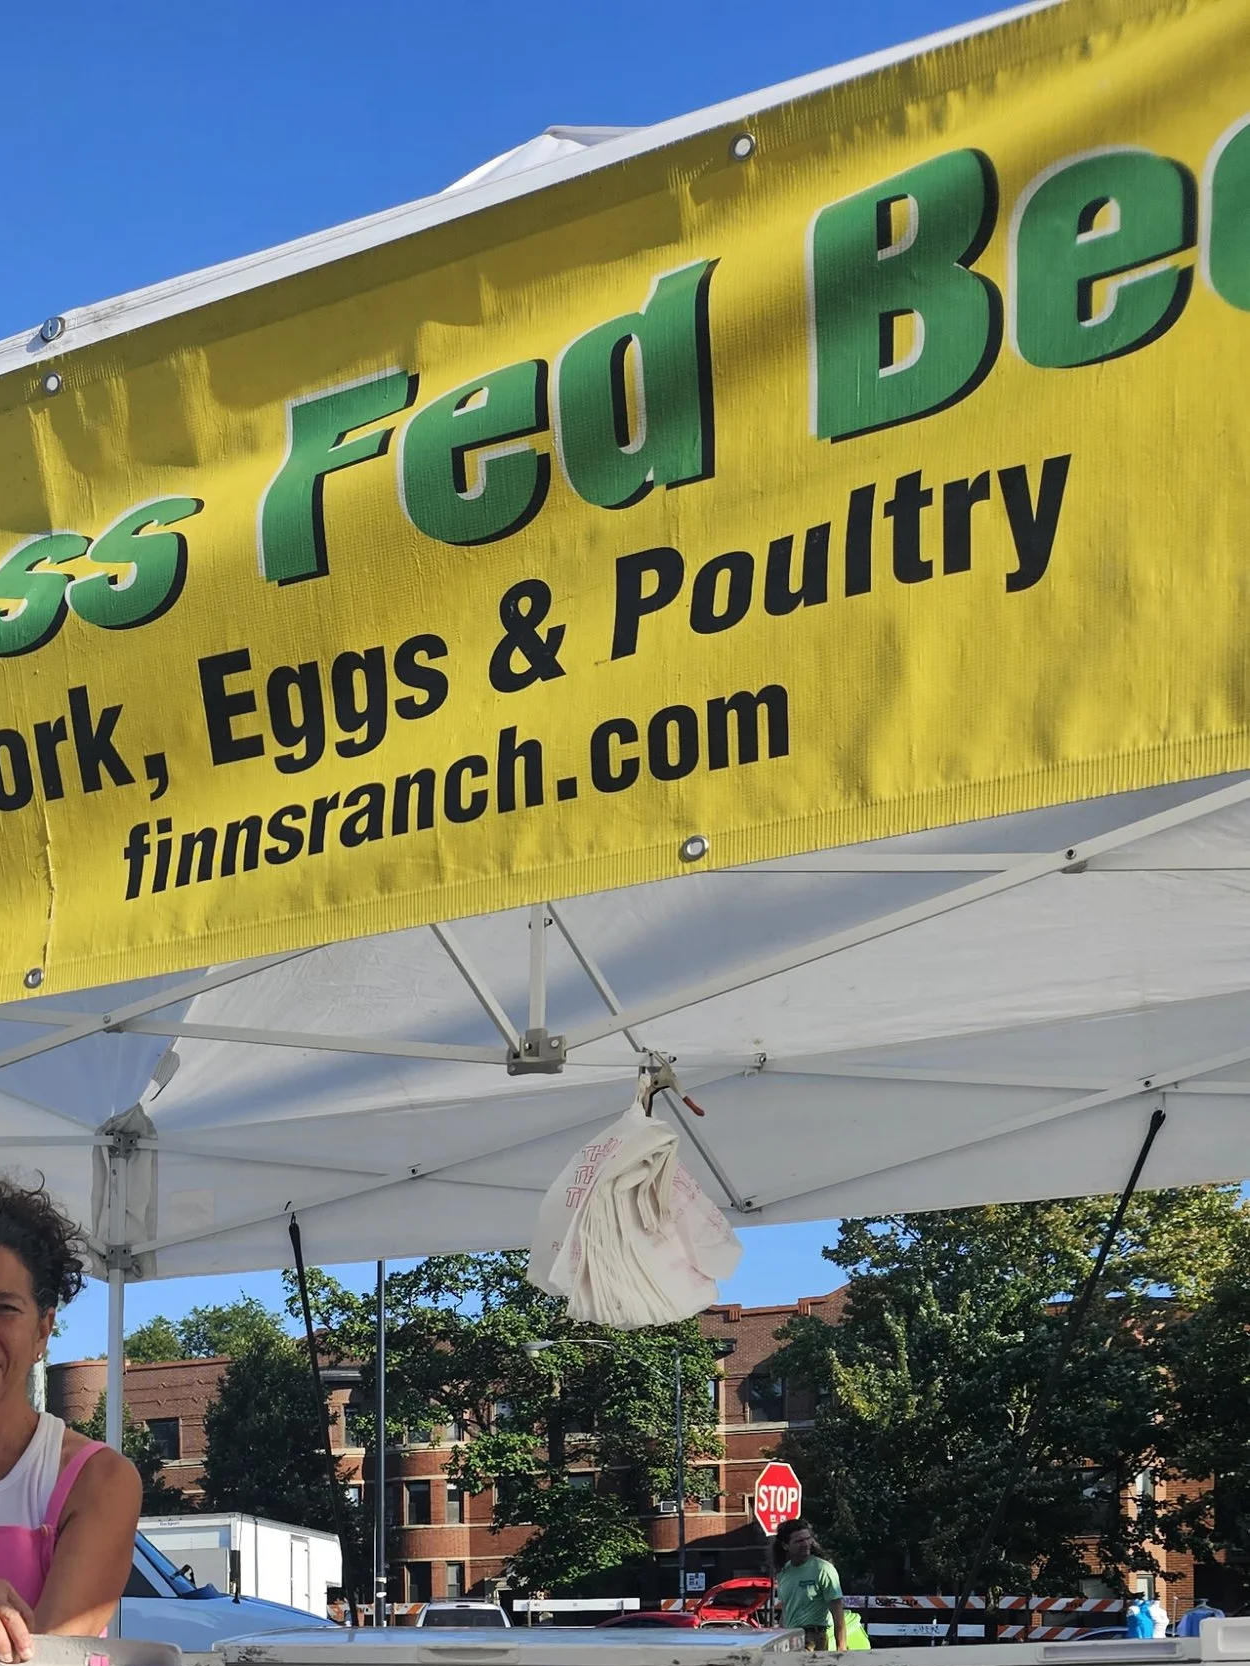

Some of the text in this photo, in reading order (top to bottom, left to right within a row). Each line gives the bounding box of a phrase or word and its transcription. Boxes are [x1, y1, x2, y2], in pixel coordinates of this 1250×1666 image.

[258, 256, 722, 586] Fed
[803, 110, 1250, 445] Be
[198, 632, 450, 775] Eggs
[488, 578, 567, 693] &
[610, 453, 1072, 662] Poultry
[123, 683, 790, 900] finnsranch.com
[758, 1485, 798, 1512] STOP
